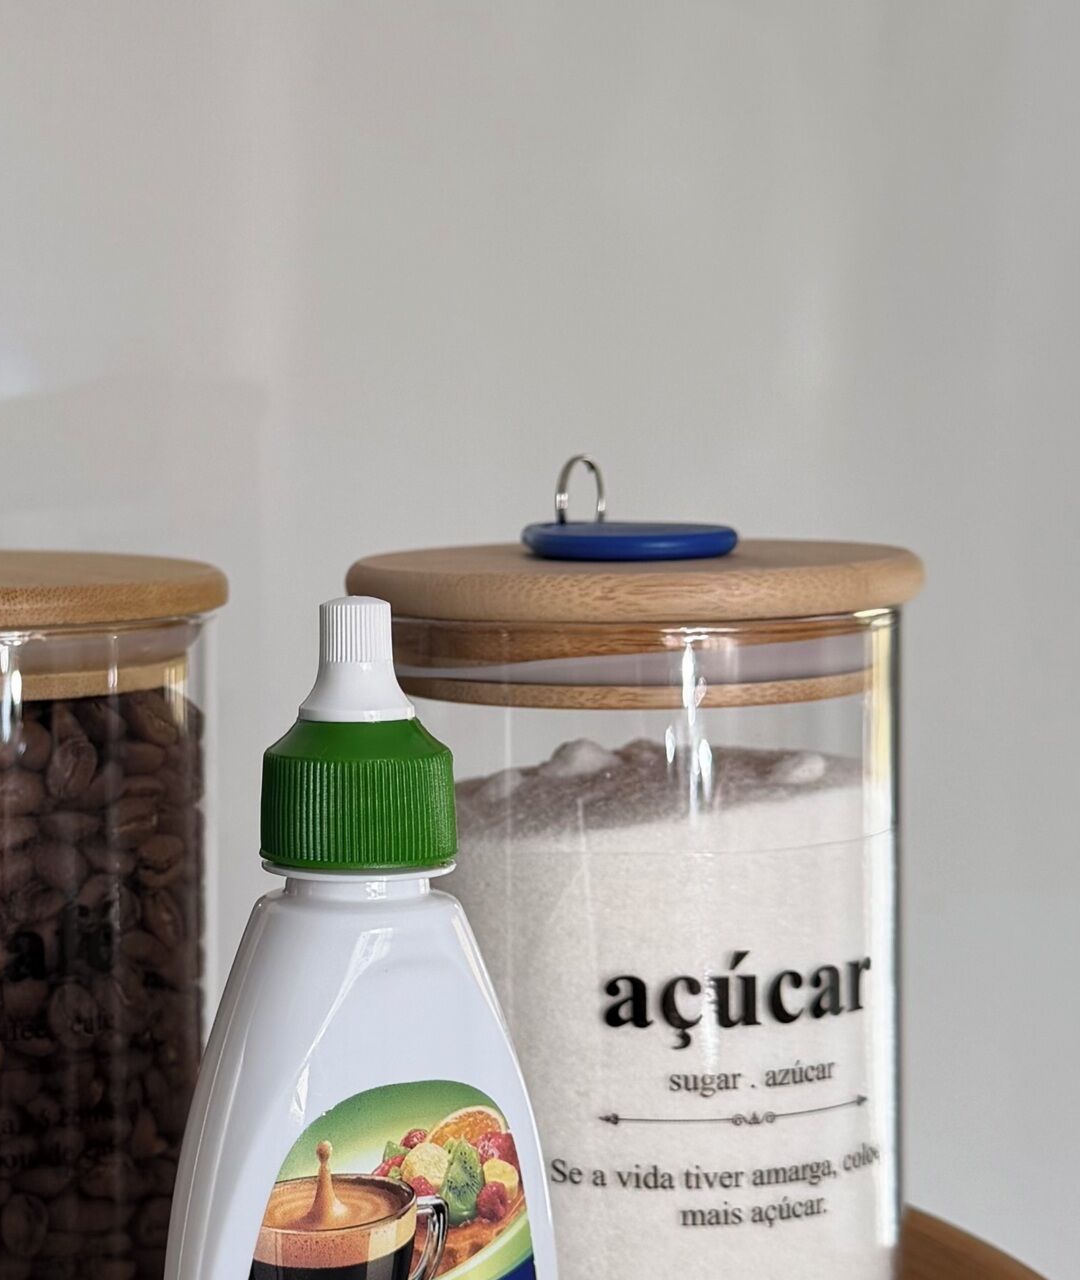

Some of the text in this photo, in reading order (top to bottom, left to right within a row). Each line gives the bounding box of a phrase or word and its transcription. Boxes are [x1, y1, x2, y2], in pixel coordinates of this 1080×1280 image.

[603, 950, 871, 1050] açúcar
[669, 1073, 741, 1098] sugar
[764, 1060, 835, 1088] azúcar
[550, 1158, 583, 1185] Se
[592, 1168, 607, 1187] a
[617, 1164, 675, 1190] vida
[683, 1165, 744, 1189] tiver
[752, 1159, 837, 1186] amarga,
[680, 1196, 827, 1228] mais açúcar.
